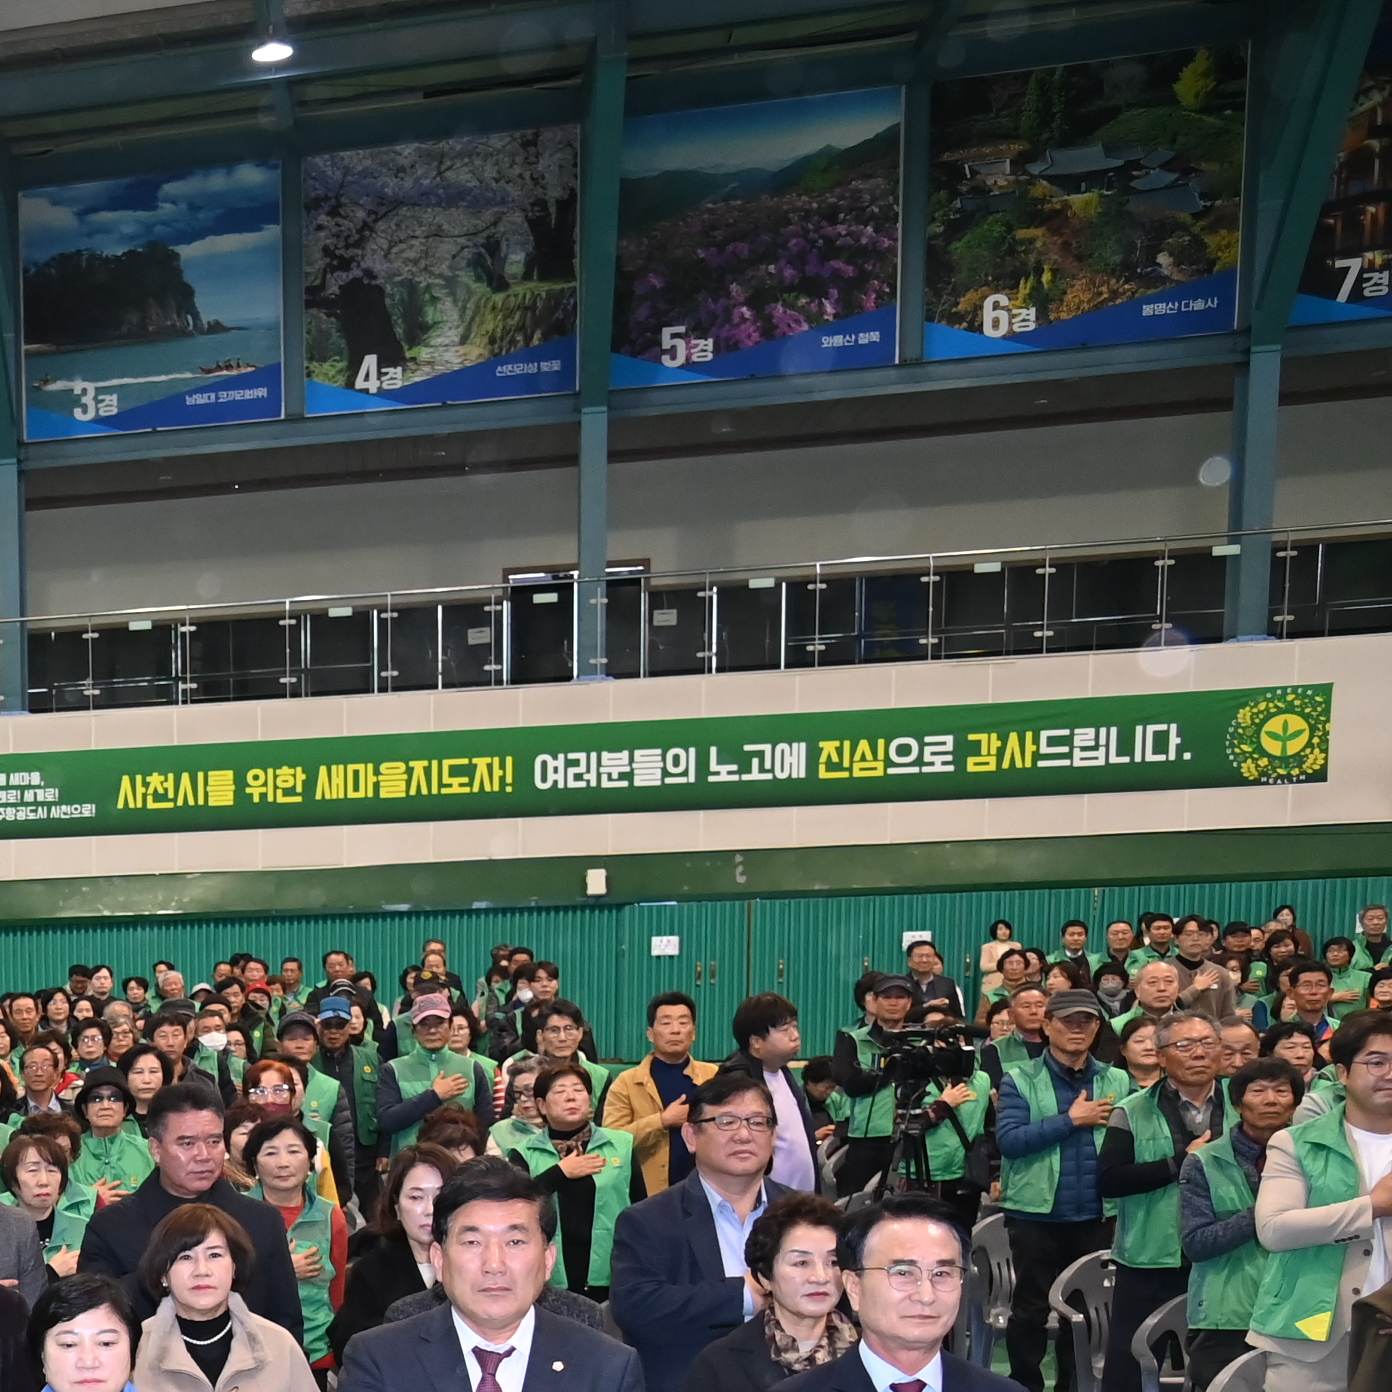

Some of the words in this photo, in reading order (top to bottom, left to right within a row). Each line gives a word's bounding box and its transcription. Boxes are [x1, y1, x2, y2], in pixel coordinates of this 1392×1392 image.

[1334, 257, 1390, 304] 7경
[982, 293, 1037, 337] 6경
[1141, 300, 1179, 317] 봉명산
[1181, 297, 1219, 312] 다솔사
[660, 325, 715, 367] 5경
[820, 333, 856, 348] 와룡산
[857, 331, 881, 346] 철쭉
[354, 354, 403, 394] 4경
[495, 361, 538, 377] 선진리성
[540, 359, 562, 373] 벚꽃
[72, 381, 119, 421] 3경
[185, 391, 216, 406] 남일대
[217, 387, 268, 403] 코끼리바위
[1265, 687, 1314, 699] GREEN
[1225, 719, 1238, 768] CULTURE
[116, 769, 235, 809] 사천시를
[245, 765, 306, 803] 위한
[315, 755, 513, 800] 새마을지도자!
[534, 747, 696, 790] 여러분들의
[707, 741, 806, 782] 노고에
[818, 734, 955, 780] 진심으로
[966, 722, 1192, 773] 감사드립니다.
[9, 771, 44, 787] 새마을,
[1260, 774, 1306, 785] HEALTH
[23, 788, 59, 802] 세계로!
[50, 803, 96, 818] 사천으로!
